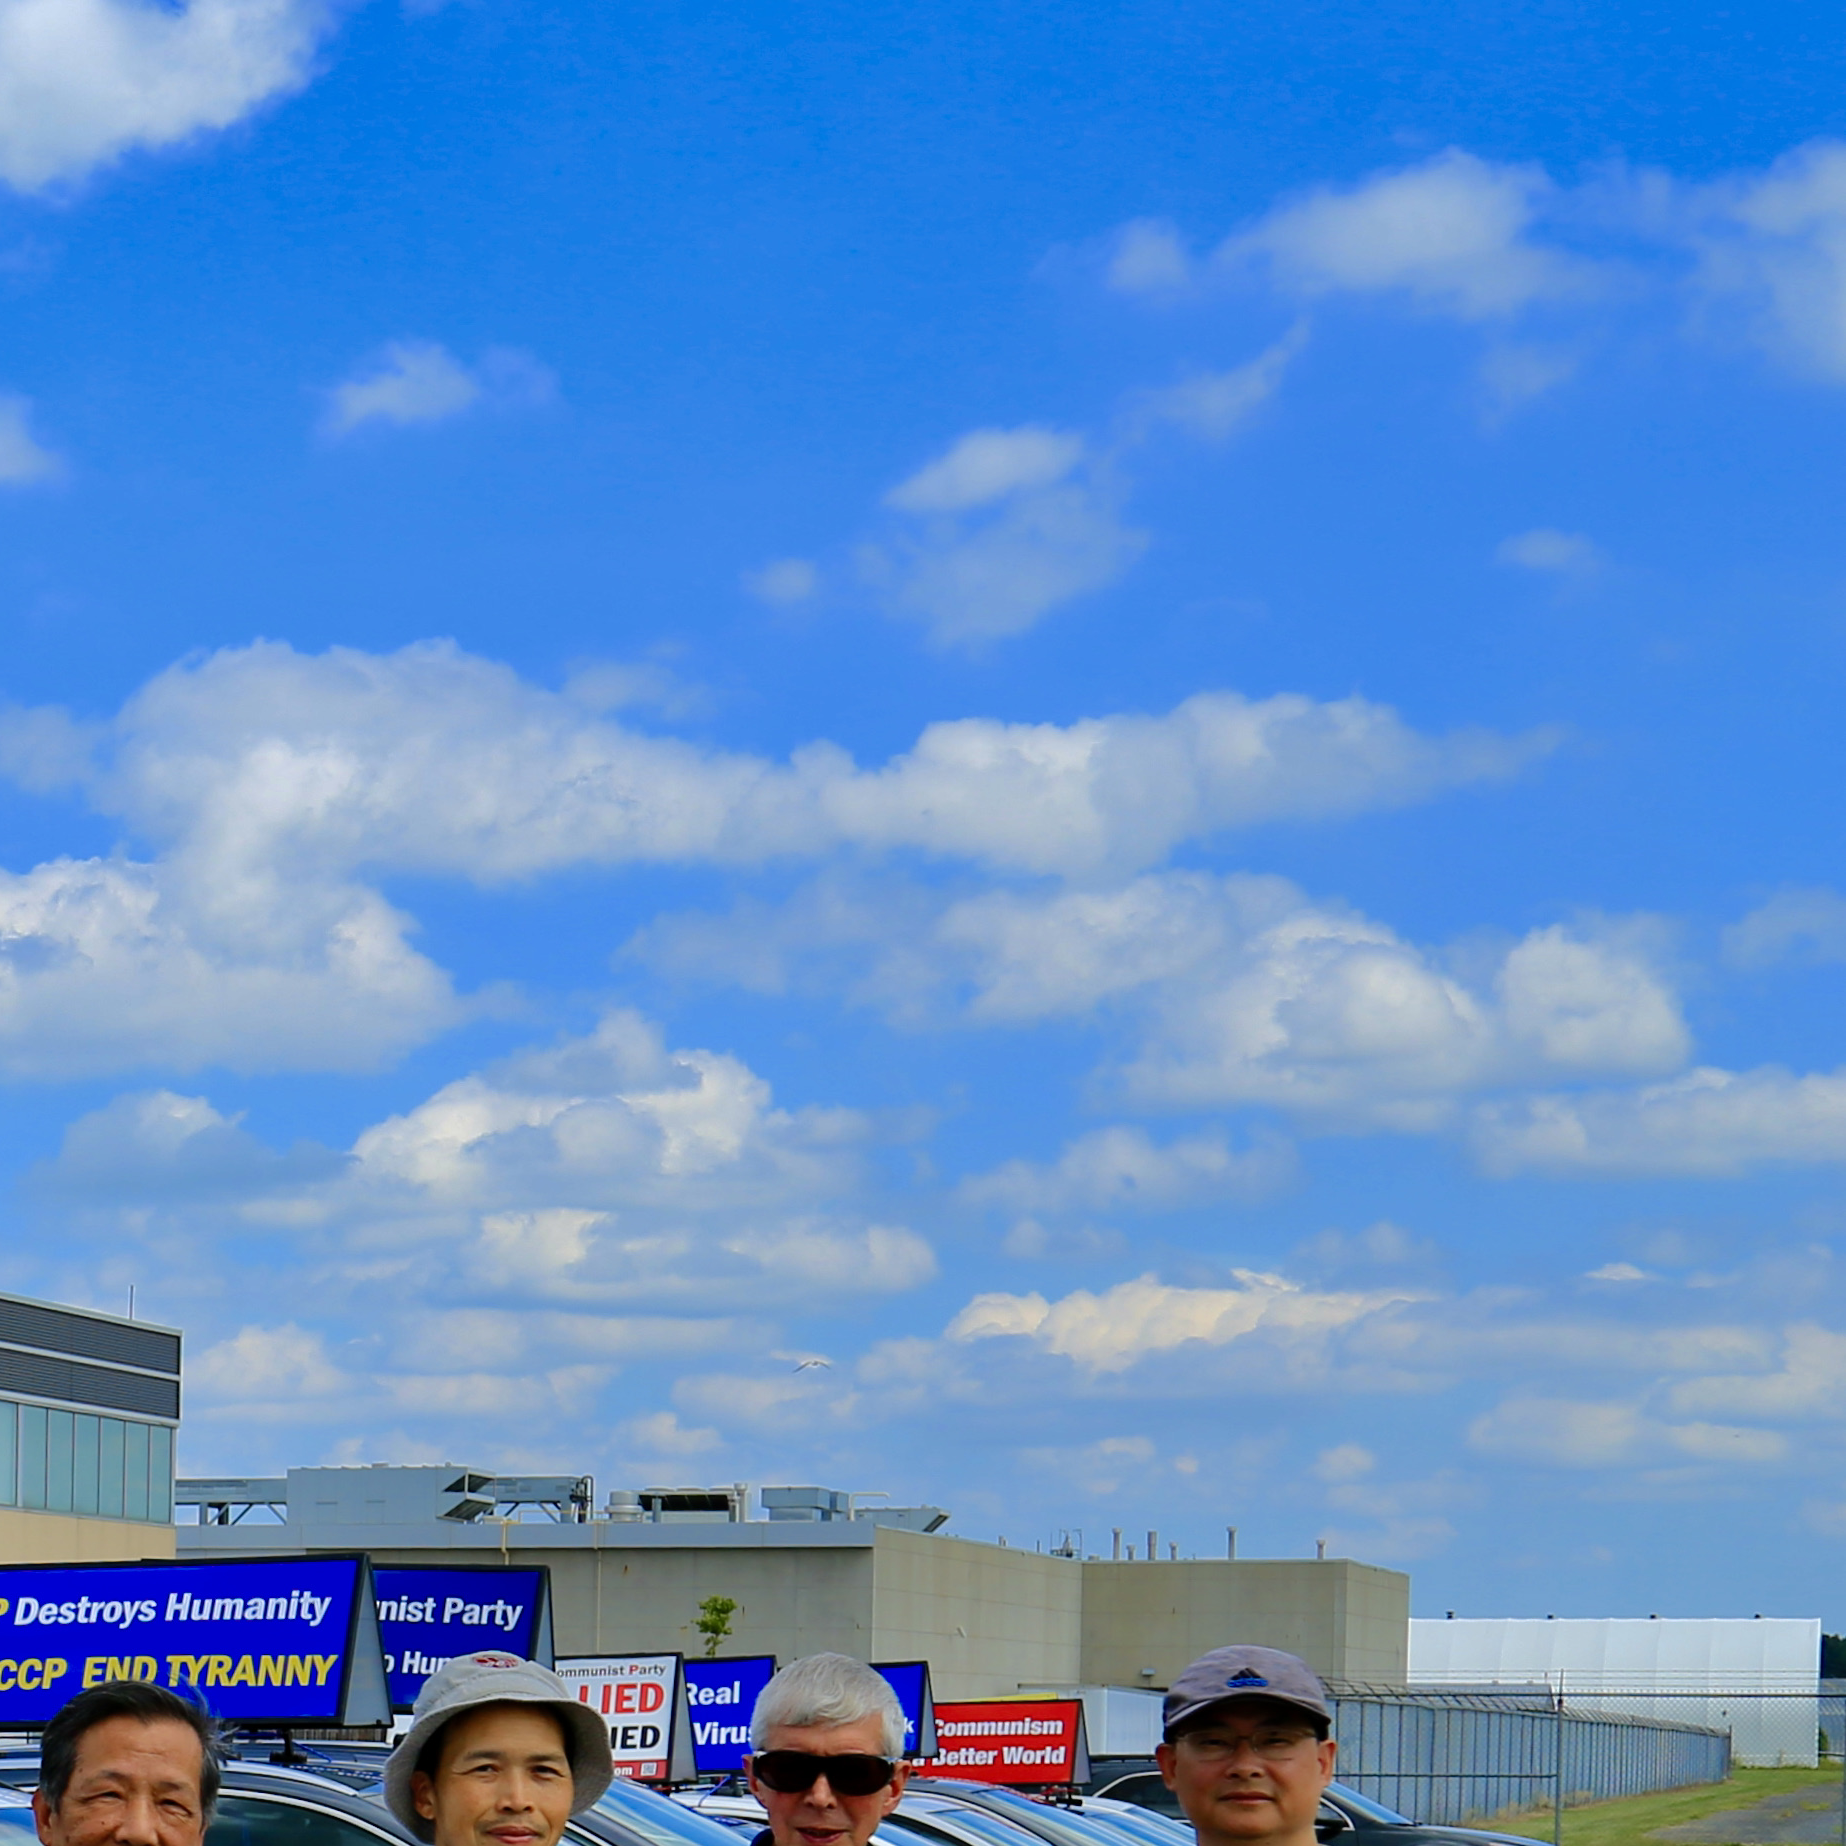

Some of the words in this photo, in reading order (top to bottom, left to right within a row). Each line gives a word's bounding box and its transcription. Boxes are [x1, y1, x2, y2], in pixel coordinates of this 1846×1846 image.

[14, 1594, 157, 1627] Destroys
[164, 1589, 331, 1625] Humanity
[376, 1595, 436, 1623] nist
[443, 1597, 523, 1630] Party
[82, 1655, 158, 1688] END
[166, 1654, 338, 1688] TYRANNY
[557, 1663, 625, 1678] ommunist
[629, 1664, 666, 1677] Party
[686, 1681, 740, 1706] Real
[611, 1725, 660, 1749] IED
[935, 1717, 1063, 1737] Communism
[932, 1747, 998, 1766] Better
[1002, 1746, 1066, 1765] World
